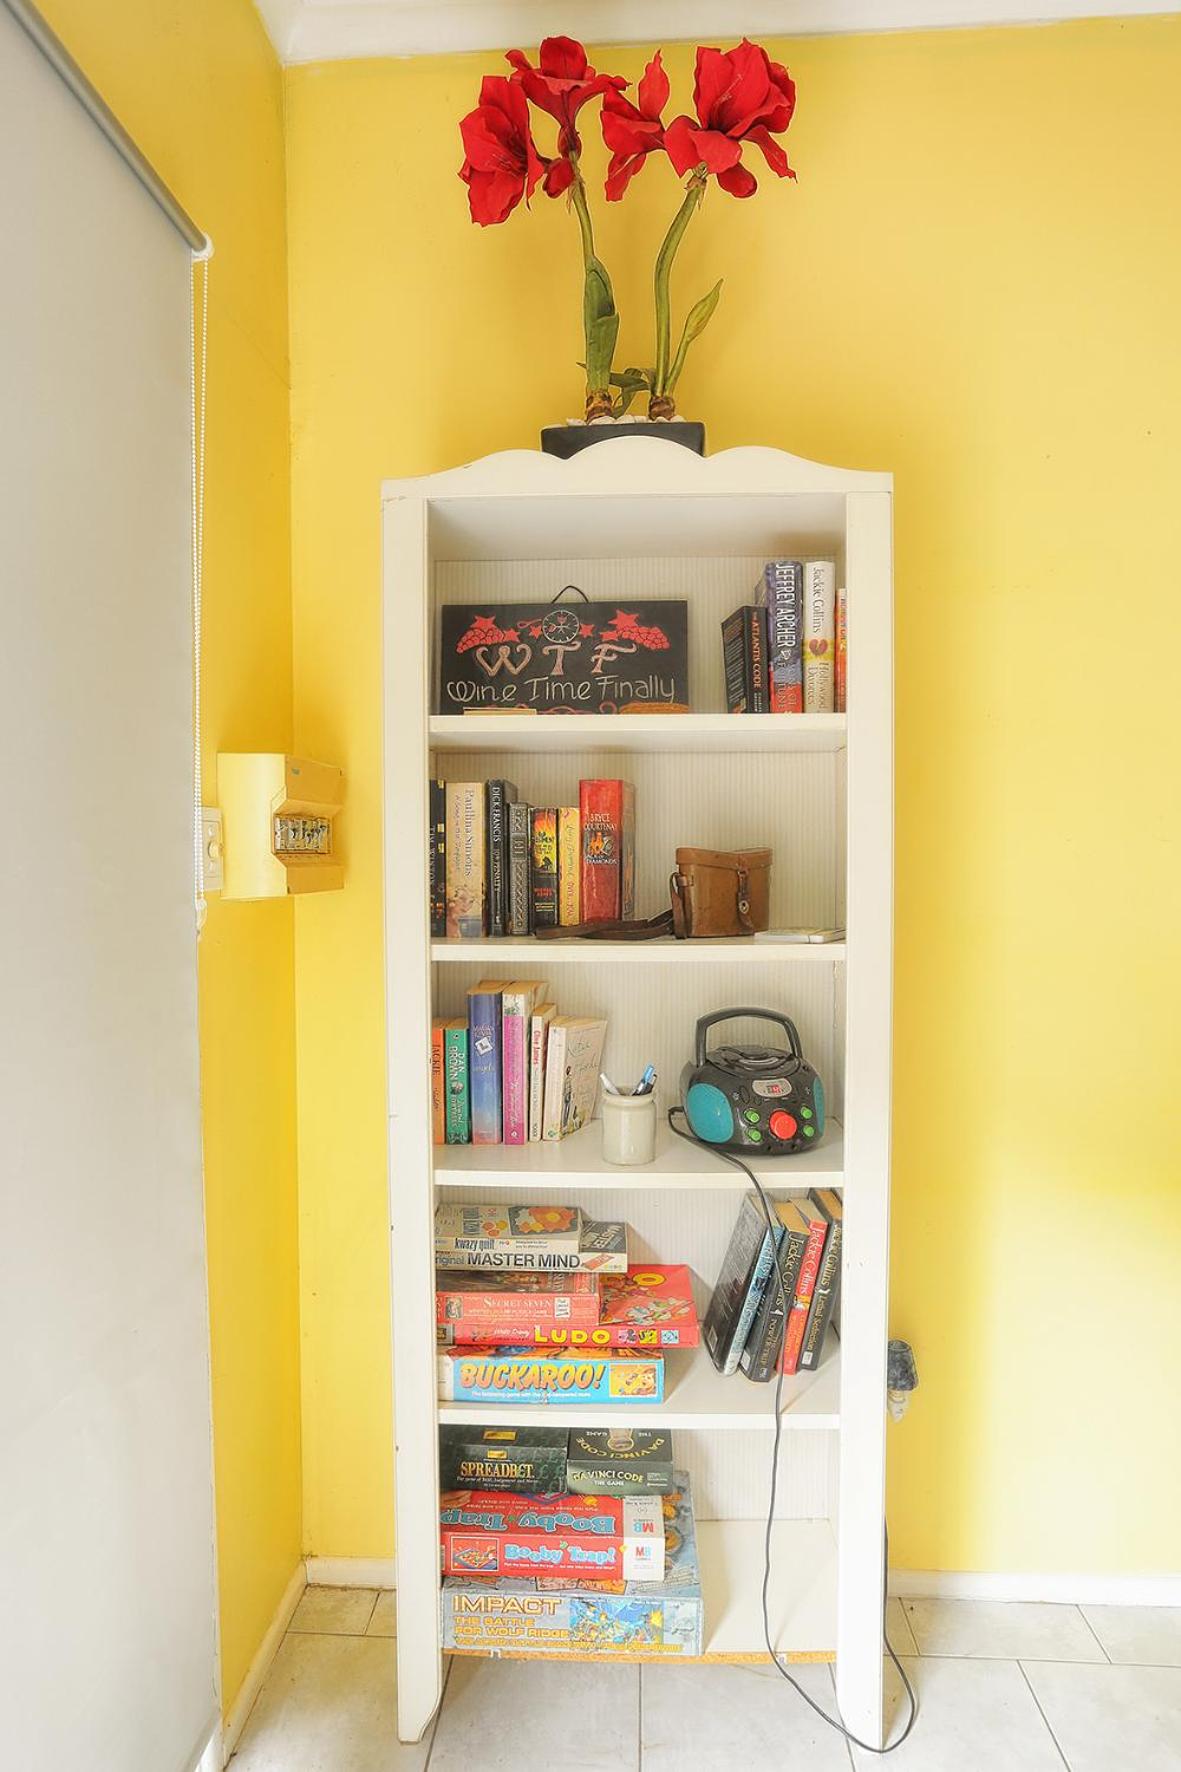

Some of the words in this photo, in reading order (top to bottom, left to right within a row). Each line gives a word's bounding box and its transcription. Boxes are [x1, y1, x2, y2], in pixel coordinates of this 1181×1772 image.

[776, 563, 795, 607] JEFFREY
[812, 567, 825, 598] Jackie
[776, 608, 796, 647] ARCHER
[812, 599, 825, 634] Collins
[752, 620, 760, 662] ATLANTIS
[752, 664, 761, 689] CODE
[447, 681, 517, 703] Wine
[524, 676, 592, 702] Time
[594, 675, 676, 704] Finally
[492, 787, 500, 807] DICK
[492, 809, 501, 842] FRANCIS
[448, 1045, 459, 1080] BROWN
[454, 1237, 478, 1251] kwazy
[480, 1237, 495, 1251] quilt
[783, 1234, 804, 1270] Jackie
[805, 1226, 827, 1262] Jackie
[467, 1252, 535, 1267] MASTER
[538, 1253, 581, 1269] MIND
[820, 1254, 837, 1288] Collins
[799, 1261, 817, 1297] Collins
[484, 1297, 520, 1308] SECRET
[524, 1299, 551, 1308] SEVEN
[534, 1325, 611, 1345] LUDO
[460, 1362, 606, 1392] BUCKAROO!
[576, 1436, 607, 1457] CODE
[610, 1450, 650, 1459] VINCI
[648, 1438, 665, 1450] DA
[587, 1470, 616, 1480] VINCI
[617, 1471, 645, 1483] CODE
[518, 1511, 616, 1535] Booby
[633, 1521, 654, 1533] MB
[504, 1543, 564, 1564] Booby
[567, 1546, 617, 1565] Trap!
[635, 1546, 653, 1557] MB
[453, 1594, 562, 1616] IMPACT
[455, 1616, 480, 1626] THE
[484, 1616, 536, 1627] BATTLE
[455, 1626, 482, 1636] FOR
[486, 1627, 525, 1637] WOLF
[528, 1628, 570, 1638] RIDGE
